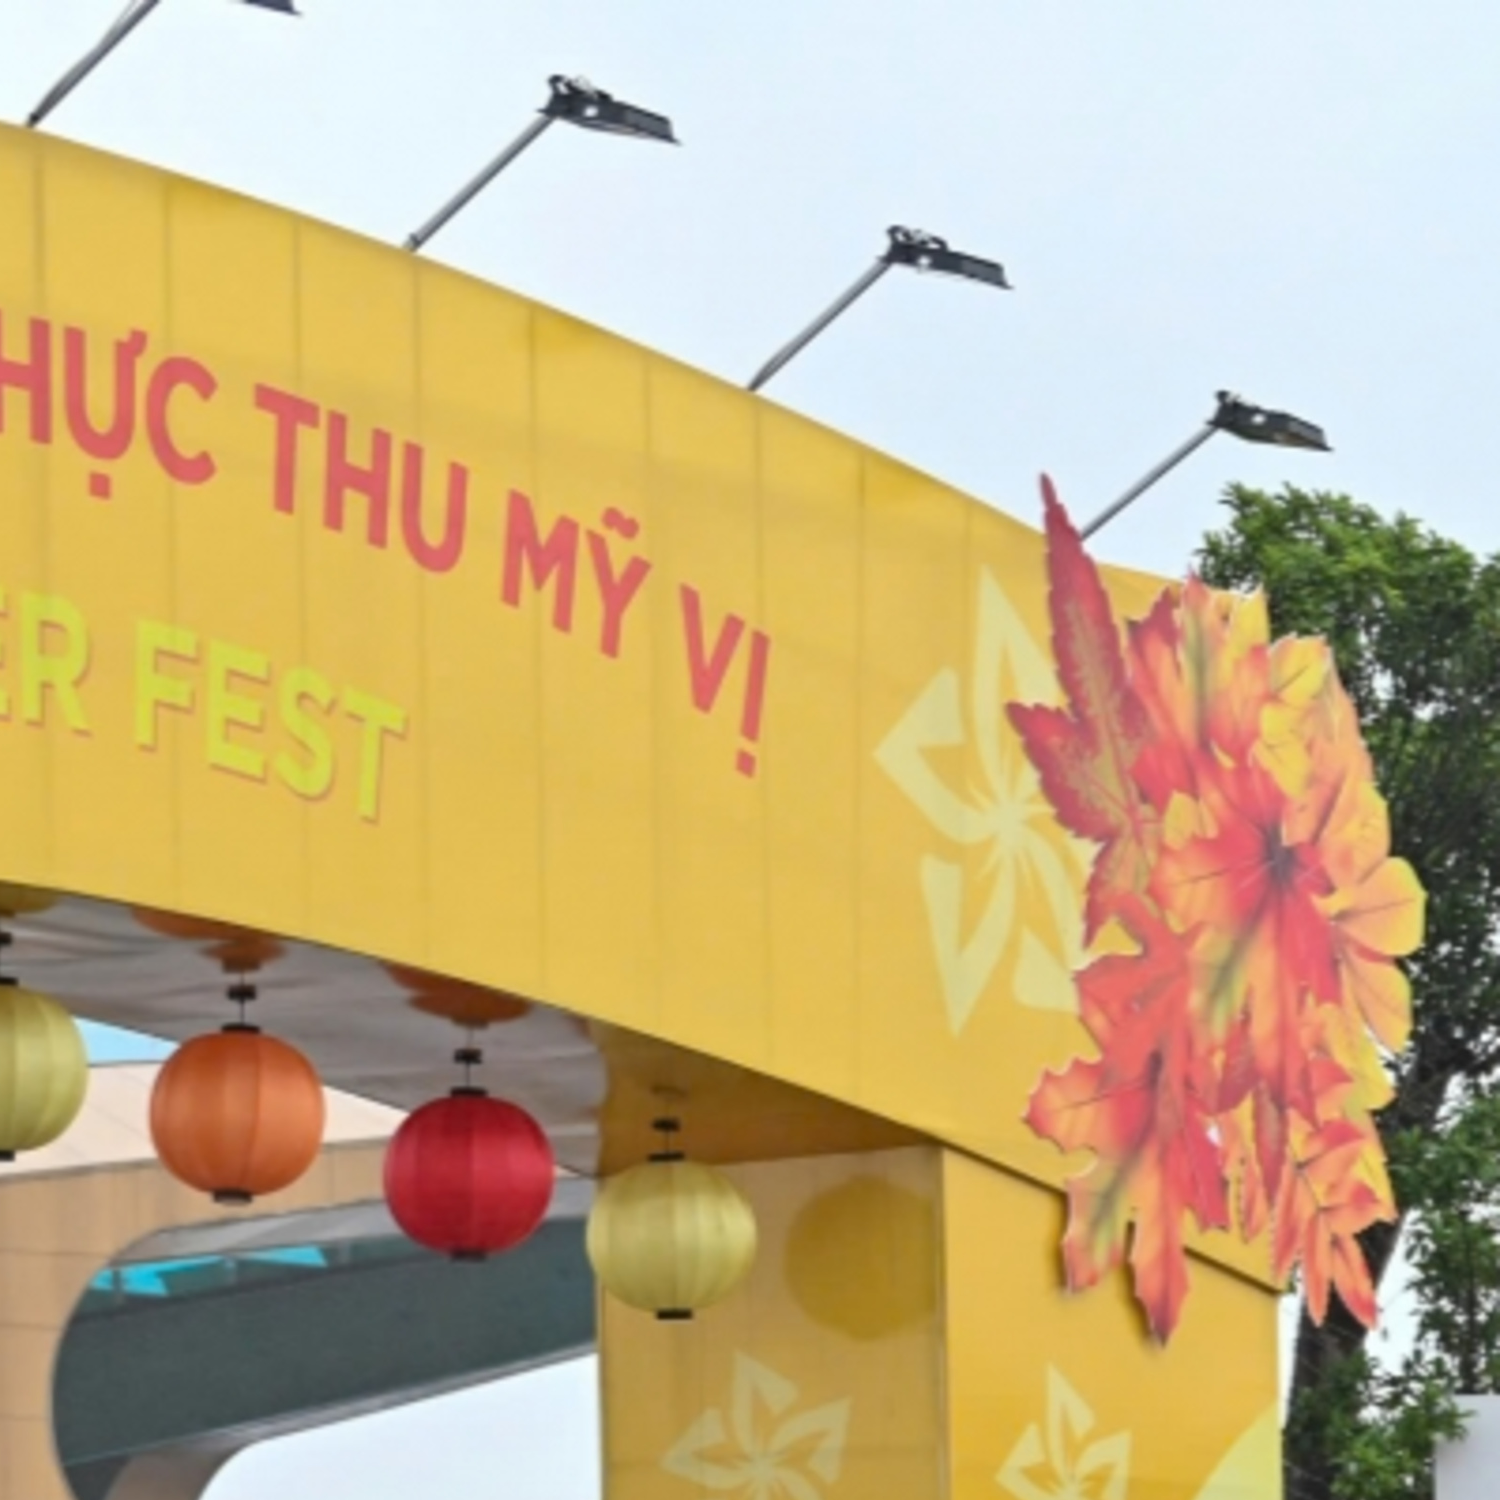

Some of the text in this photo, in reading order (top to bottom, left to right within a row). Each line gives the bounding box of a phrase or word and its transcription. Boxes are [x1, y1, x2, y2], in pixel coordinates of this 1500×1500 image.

[134, 617, 407, 824] FEST
[253, 382, 469, 574] THU
[501, 488, 652, 660] MỸ
[679, 583, 771, 778] VỊ
